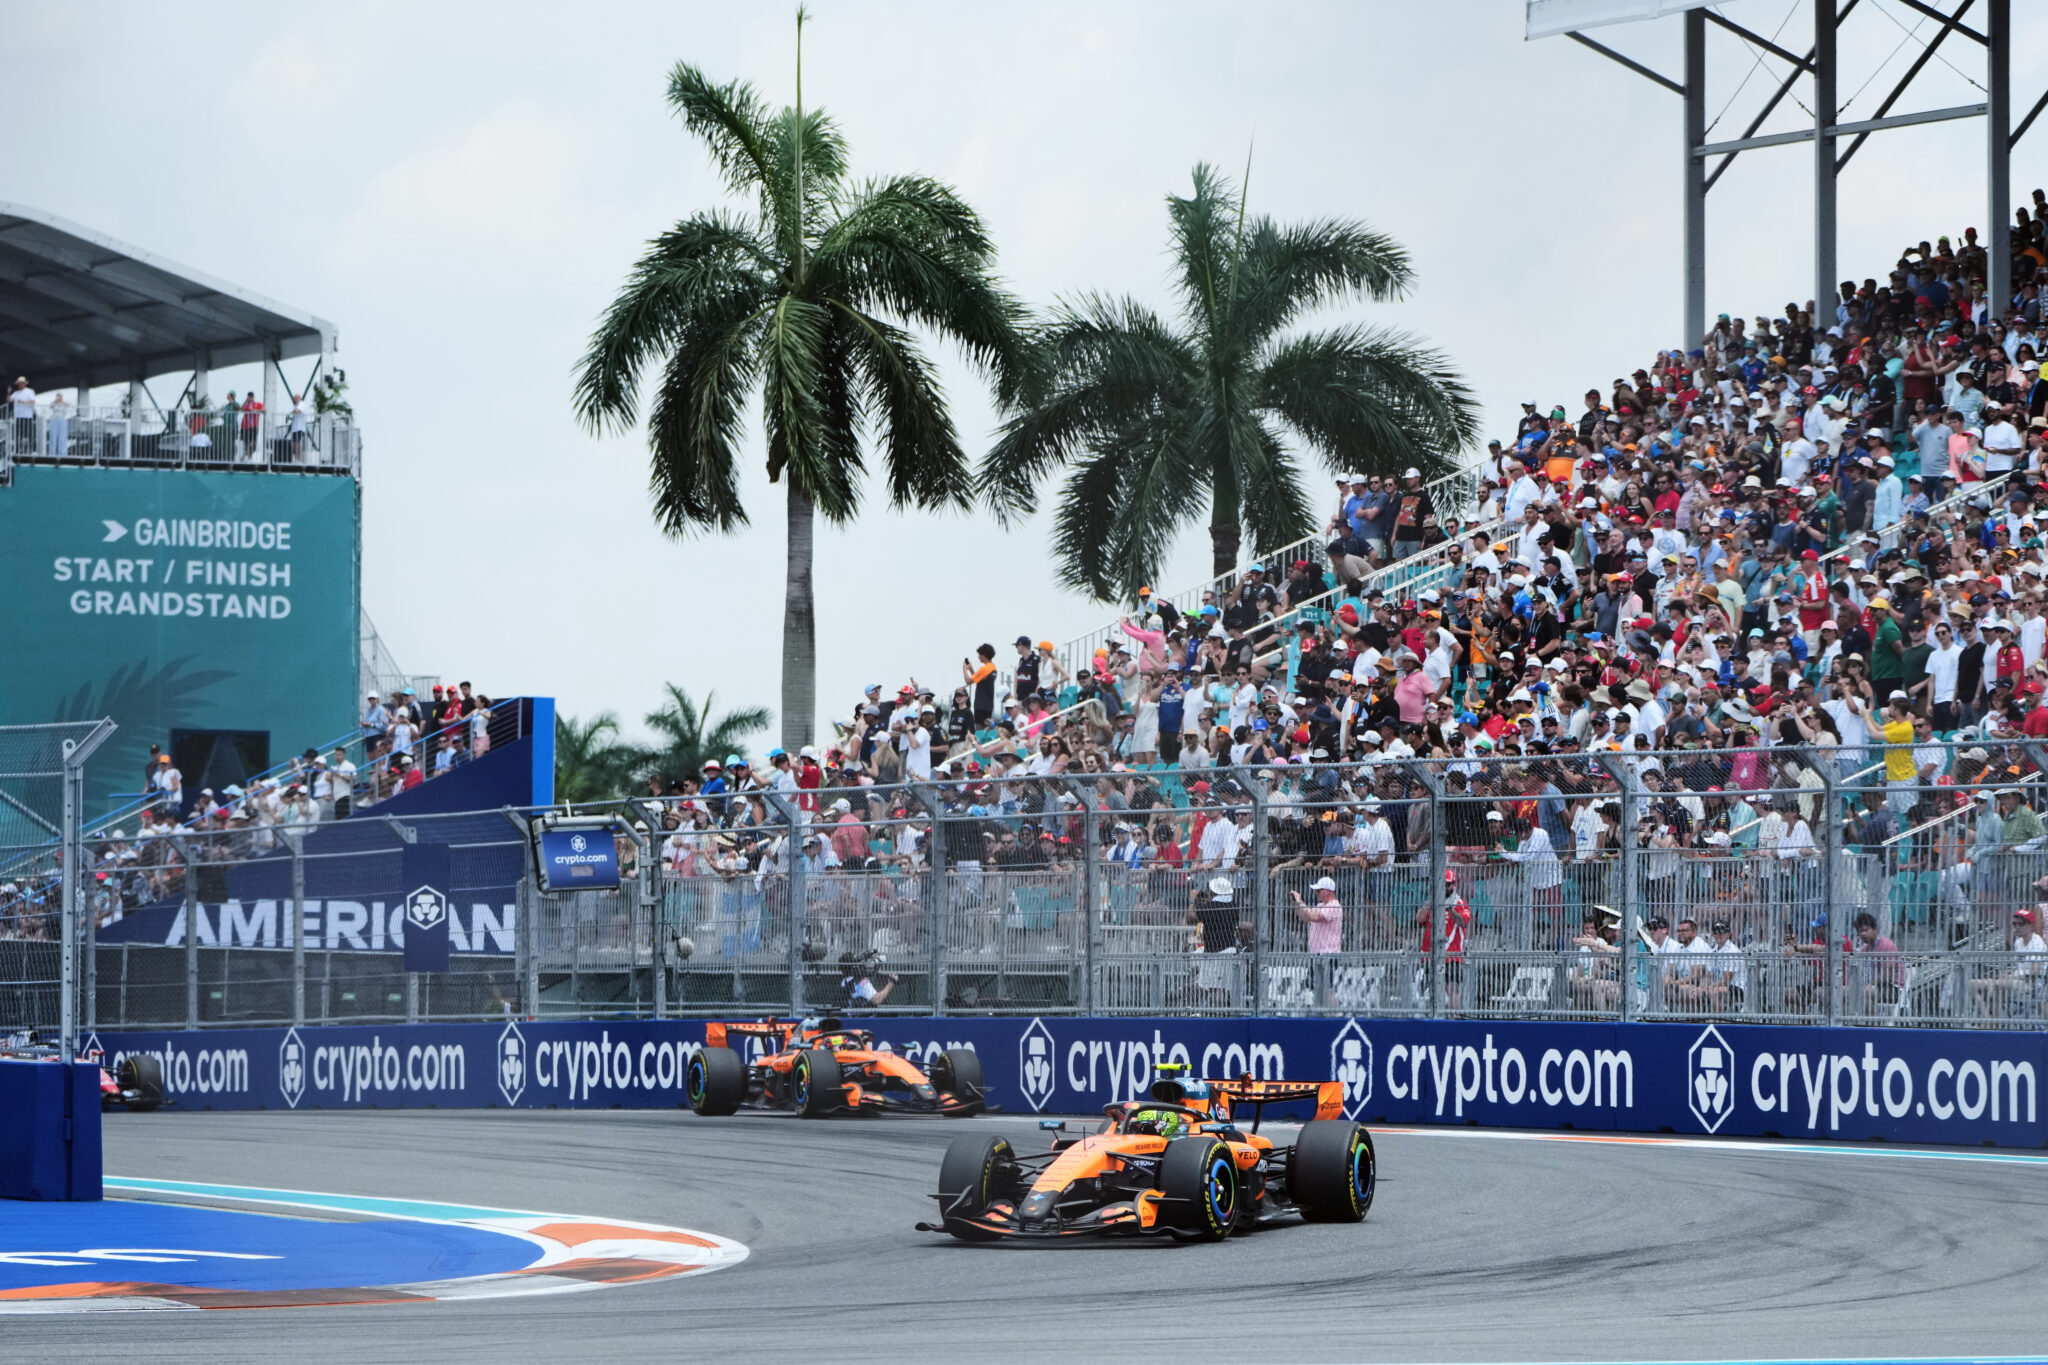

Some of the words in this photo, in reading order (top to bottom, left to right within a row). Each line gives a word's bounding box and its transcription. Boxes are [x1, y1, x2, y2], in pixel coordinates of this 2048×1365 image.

[134, 518, 291, 550] GAINBRIDGE
[53, 556, 153, 583] START
[164, 559, 175, 584] /
[186, 559, 291, 587] FINISH
[70, 589, 291, 619] GRANDSTAND
[554, 853, 608, 866] crypto.com
[112, 1040, 249, 1094] cto.com
[313, 1035, 466, 1102] crypto.com
[535, 1030, 702, 1100] crypto.com
[1067, 1029, 1285, 1103] cryptocom
[1386, 1033, 1633, 1117] crypto.com
[1751, 1042, 2037, 1131] crypto.com
[1237, 1151, 1258, 1160] VELO
